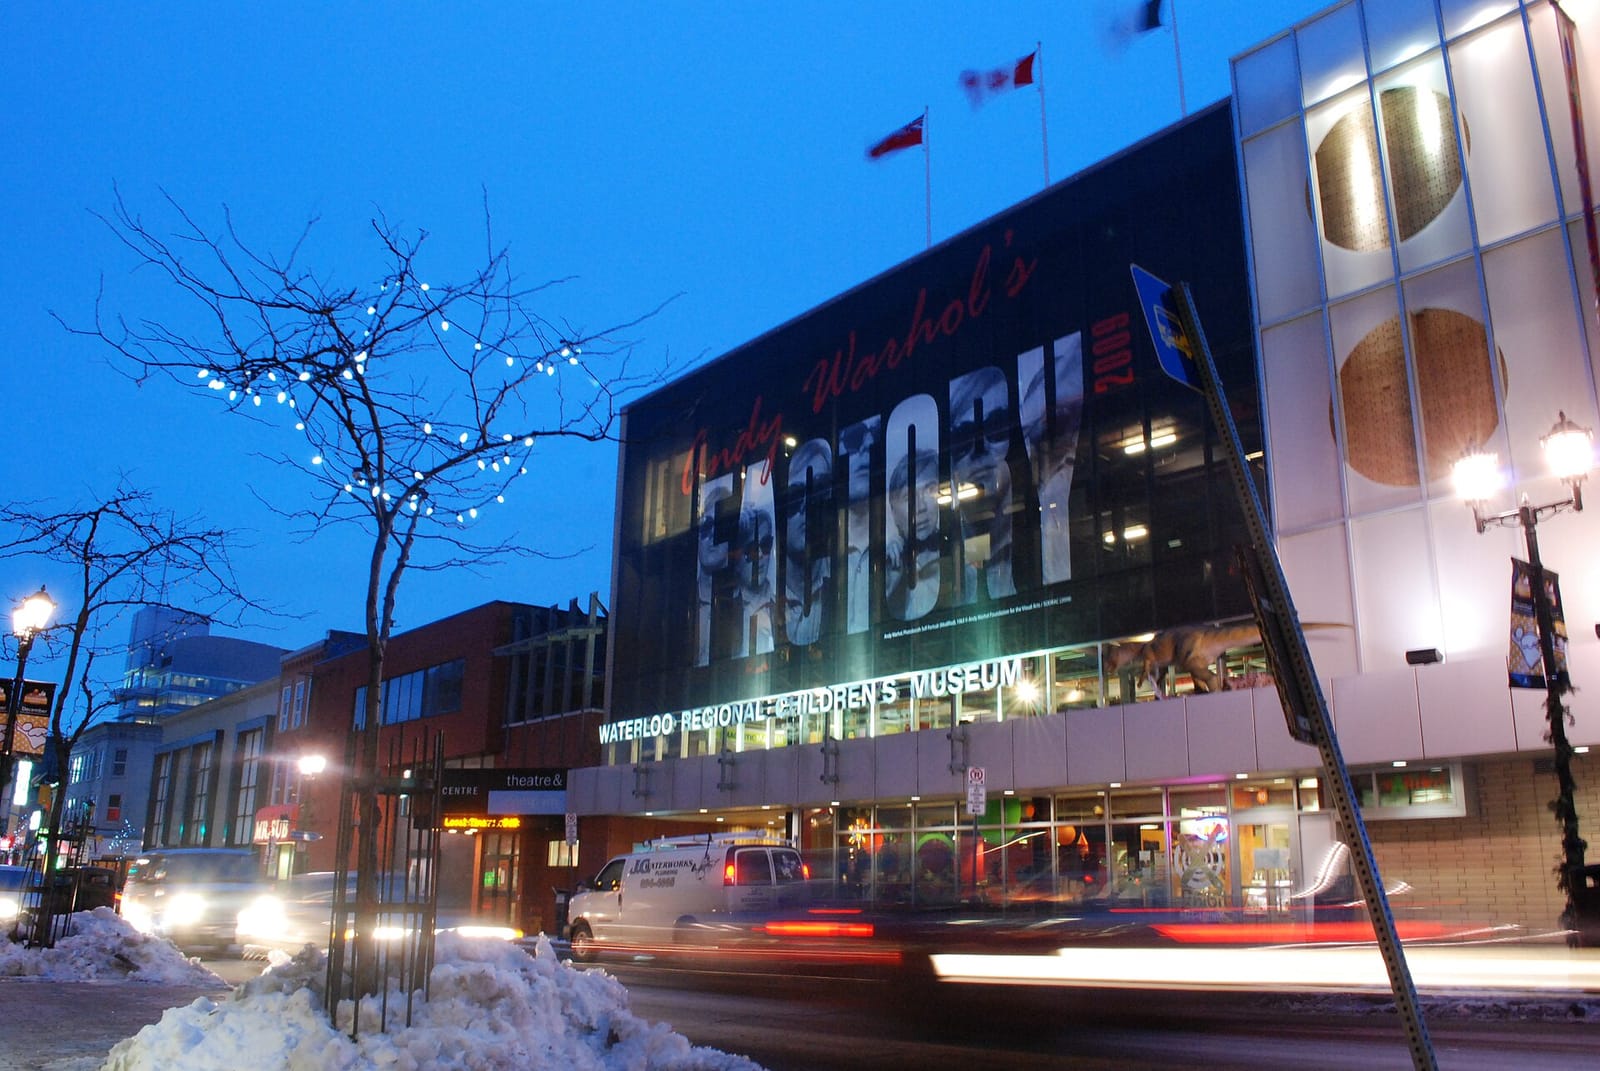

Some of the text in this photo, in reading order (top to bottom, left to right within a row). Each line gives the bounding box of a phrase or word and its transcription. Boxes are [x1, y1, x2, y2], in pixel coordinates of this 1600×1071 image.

[681, 229, 1038, 496] Andy Warhol's
[695, 330, 1084, 668] FACTORY
[599, 713, 675, 744] WATERLOO
[681, 698, 766, 732] REGIONAL
[776, 679, 898, 718] CHILDREN'S
[910, 658, 1021, 699] MUSEUM
[442, 786, 479, 796] CENTRE
[507, 773, 562, 787] theatre &
[271, 819, 288, 838] SUB
